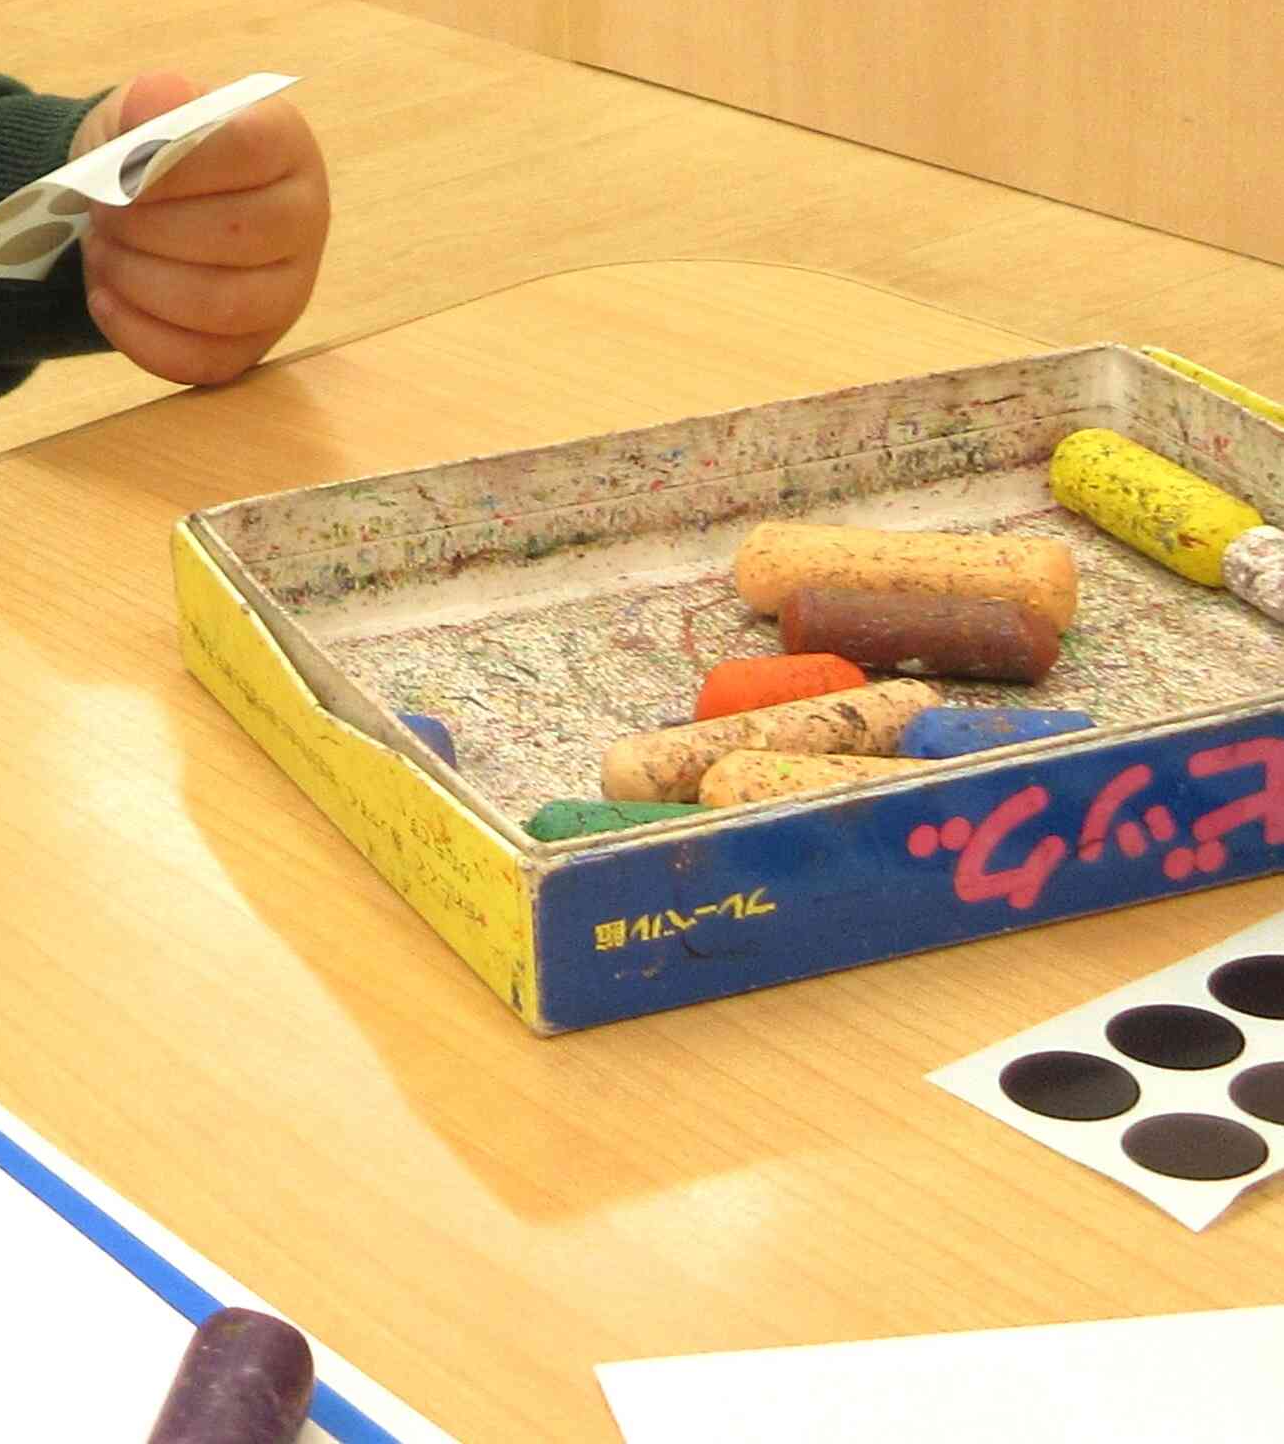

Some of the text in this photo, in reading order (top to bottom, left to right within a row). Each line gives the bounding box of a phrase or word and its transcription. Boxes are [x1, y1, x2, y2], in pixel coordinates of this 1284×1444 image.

[593, 886, 778, 951] フレーベル館
